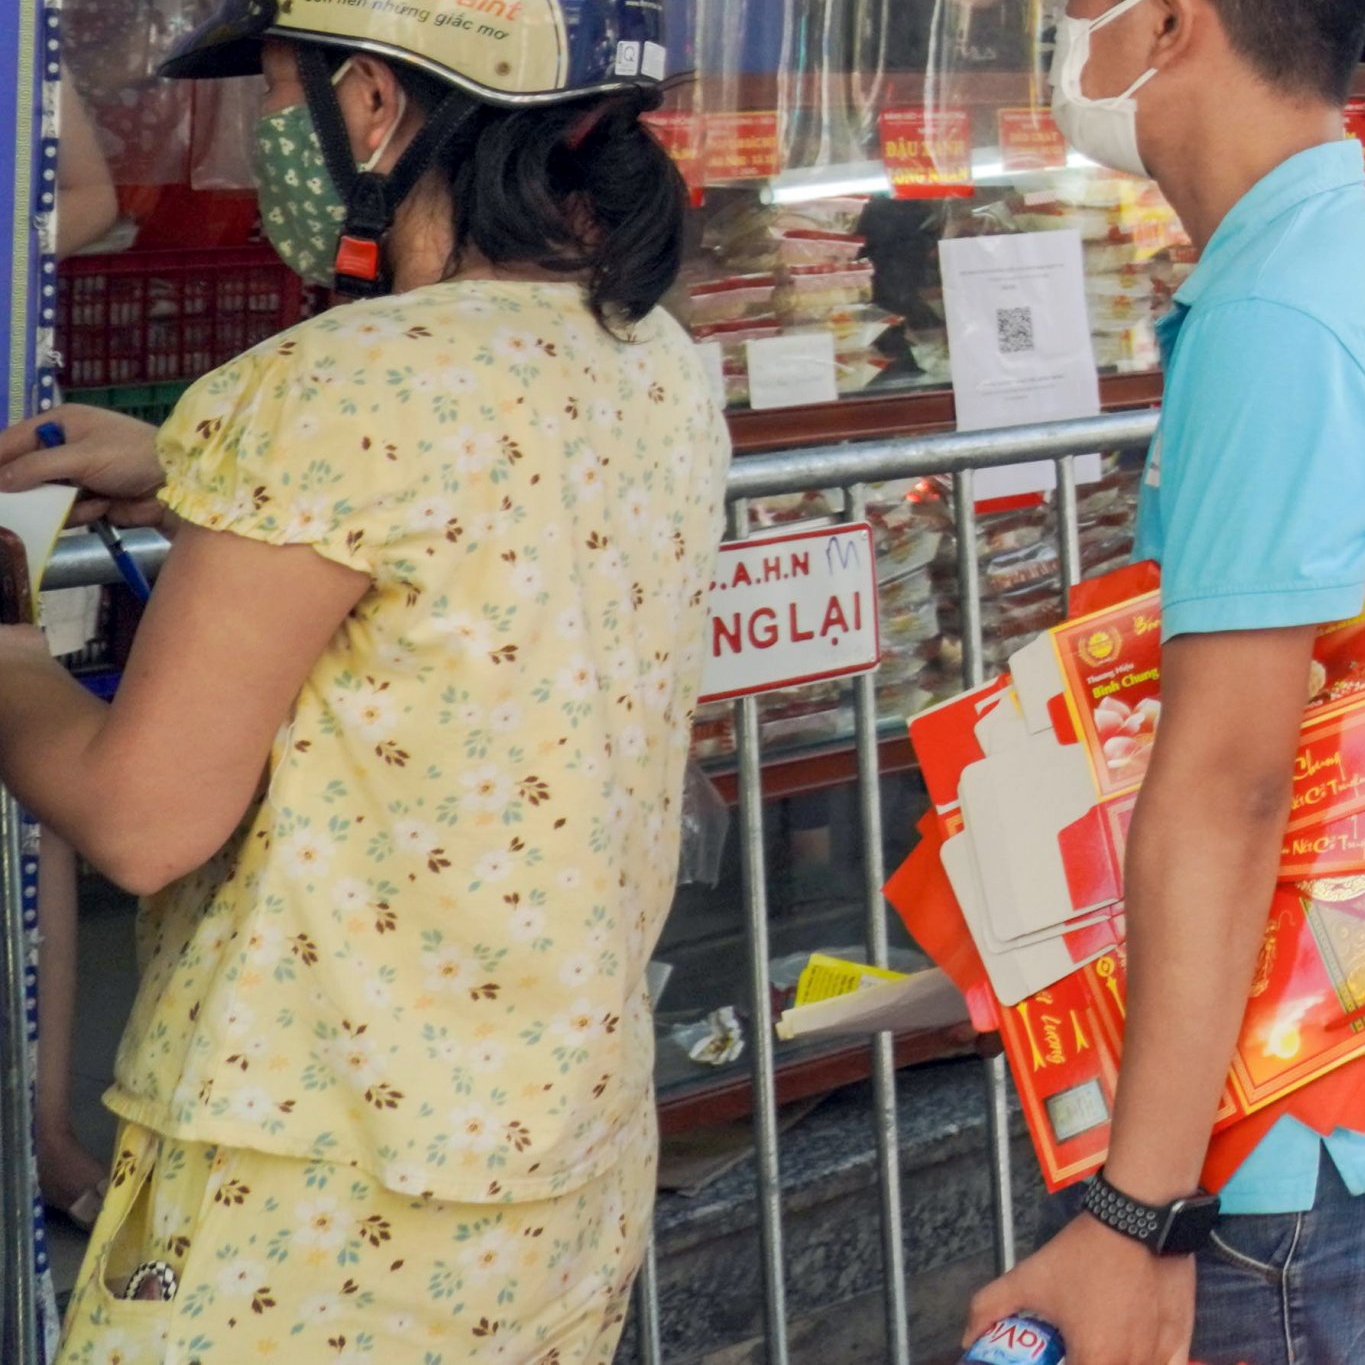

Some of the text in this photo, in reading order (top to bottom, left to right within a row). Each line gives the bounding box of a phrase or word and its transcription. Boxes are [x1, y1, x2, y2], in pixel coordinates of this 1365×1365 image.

[434, 8, 475, 32] giấc
[477, 23, 510, 41] mơ
[885, 137, 918, 161] ĐẬU
[1120, 667, 1160, 688] Chung
[1043, 1013, 1067, 1066] Lượng
